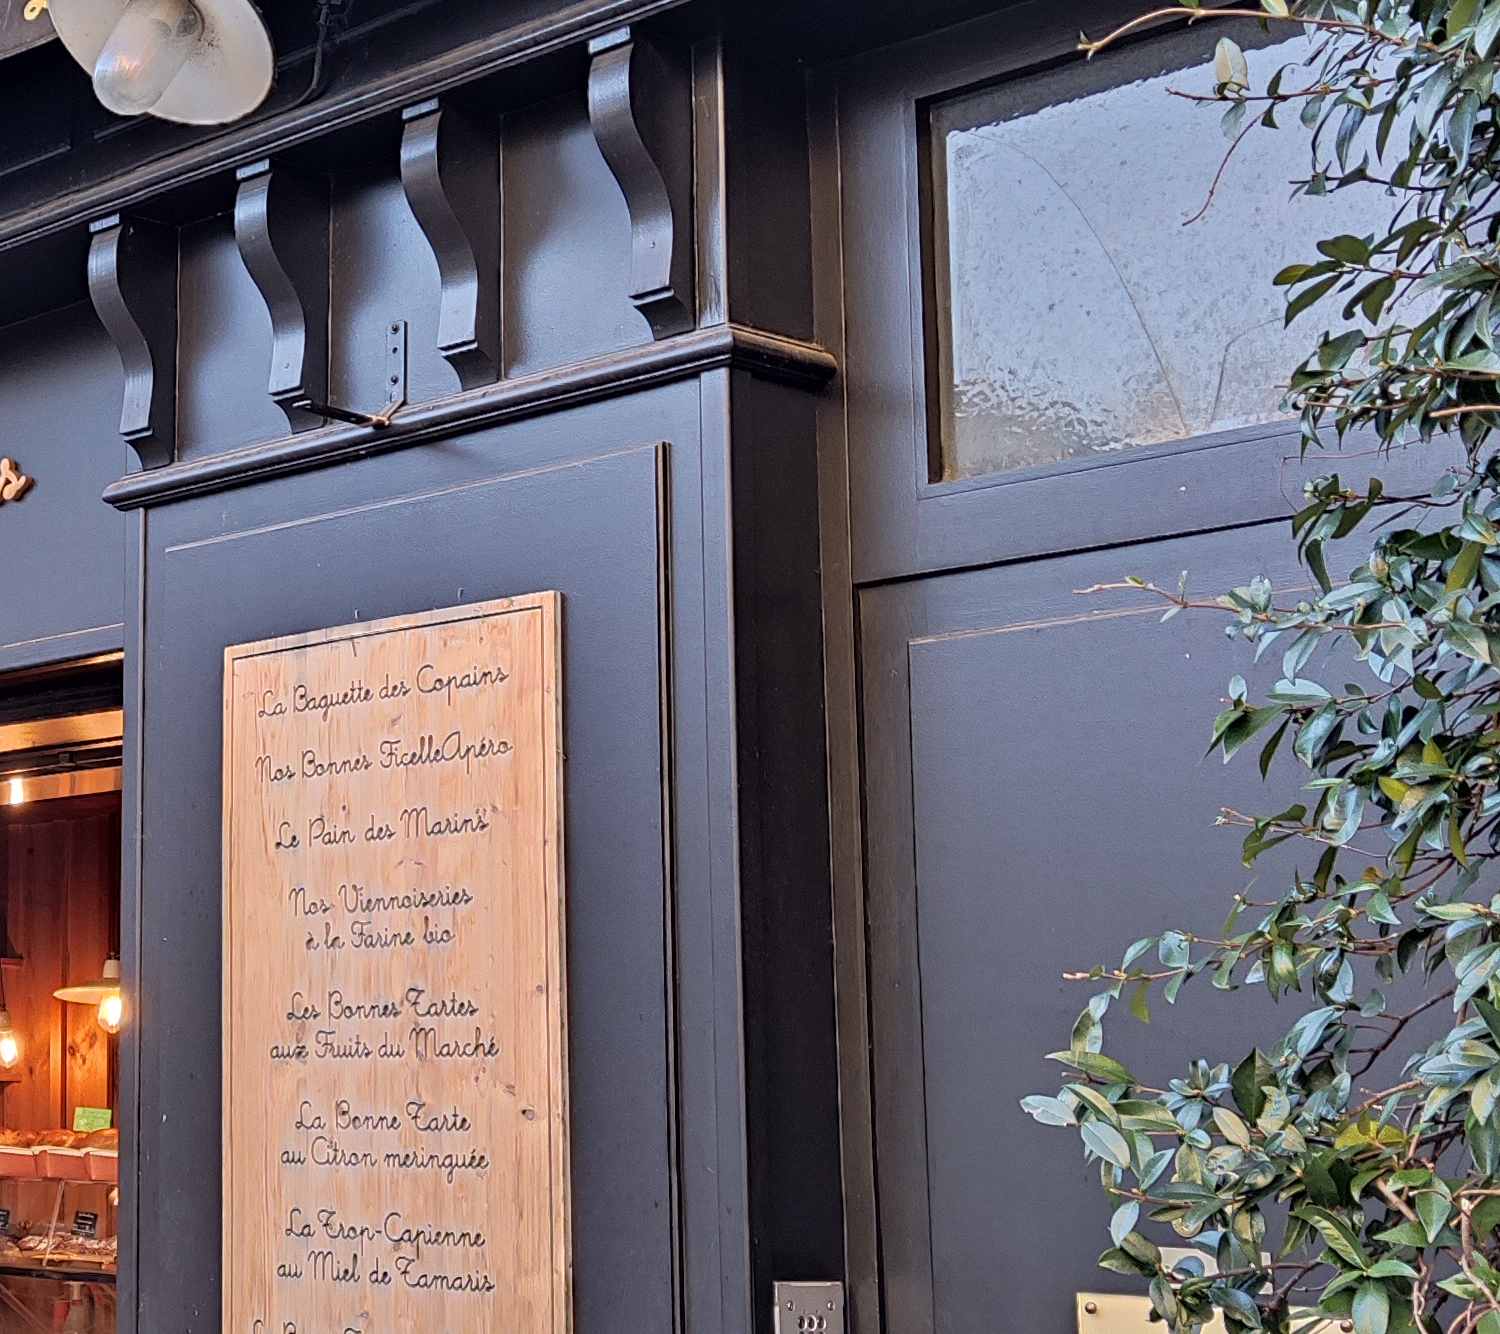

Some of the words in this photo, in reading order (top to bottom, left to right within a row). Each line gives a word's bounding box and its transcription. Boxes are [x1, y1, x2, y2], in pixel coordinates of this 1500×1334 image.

[258, 689, 287, 718] La
[293, 679, 374, 723] Baguette
[378, 673, 411, 699] des
[416, 663, 509, 706] Copains
[255, 755, 296, 784] Nos
[301, 750, 373, 779] Bonnes
[275, 821, 300, 850] Le
[308, 814, 356, 849] Pain
[364, 815, 397, 842] des
[400, 807, 489, 838] Marins
[288, 887, 331, 916] Nos
[338, 884, 474, 913] Viennoiseries
[305, 931, 320, 952] à
[324, 922, 346, 950] la
[350, 921, 415, 949] Farine
[423, 915, 456, 944] bio
[286, 992, 322, 1021] Les
[327, 990, 402, 1020] Bonnes
[405, 987, 479, 1017] Tartes
[270, 1041, 309, 1060] aux
[315, 1030, 373, 1060] Fruits
[378, 1032, 406, 1058] du
[409, 1026, 500, 1059] Marché
[294, 1100, 327, 1131] La
[335, 1100, 402, 1131] Bonne
[405, 1101, 472, 1133] Tarte
[280, 1147, 307, 1166] au
[311, 1135, 378, 1167] Citron
[383, 1146, 490, 1184] meringuée
[285, 1208, 316, 1238] La
[317, 1210, 486, 1260] Trop-Capienne
[276, 1260, 303, 1279] au
[307, 1249, 361, 1284] Miel
[369, 1257, 392, 1286] de
[395, 1256, 496, 1294] Tamaris
